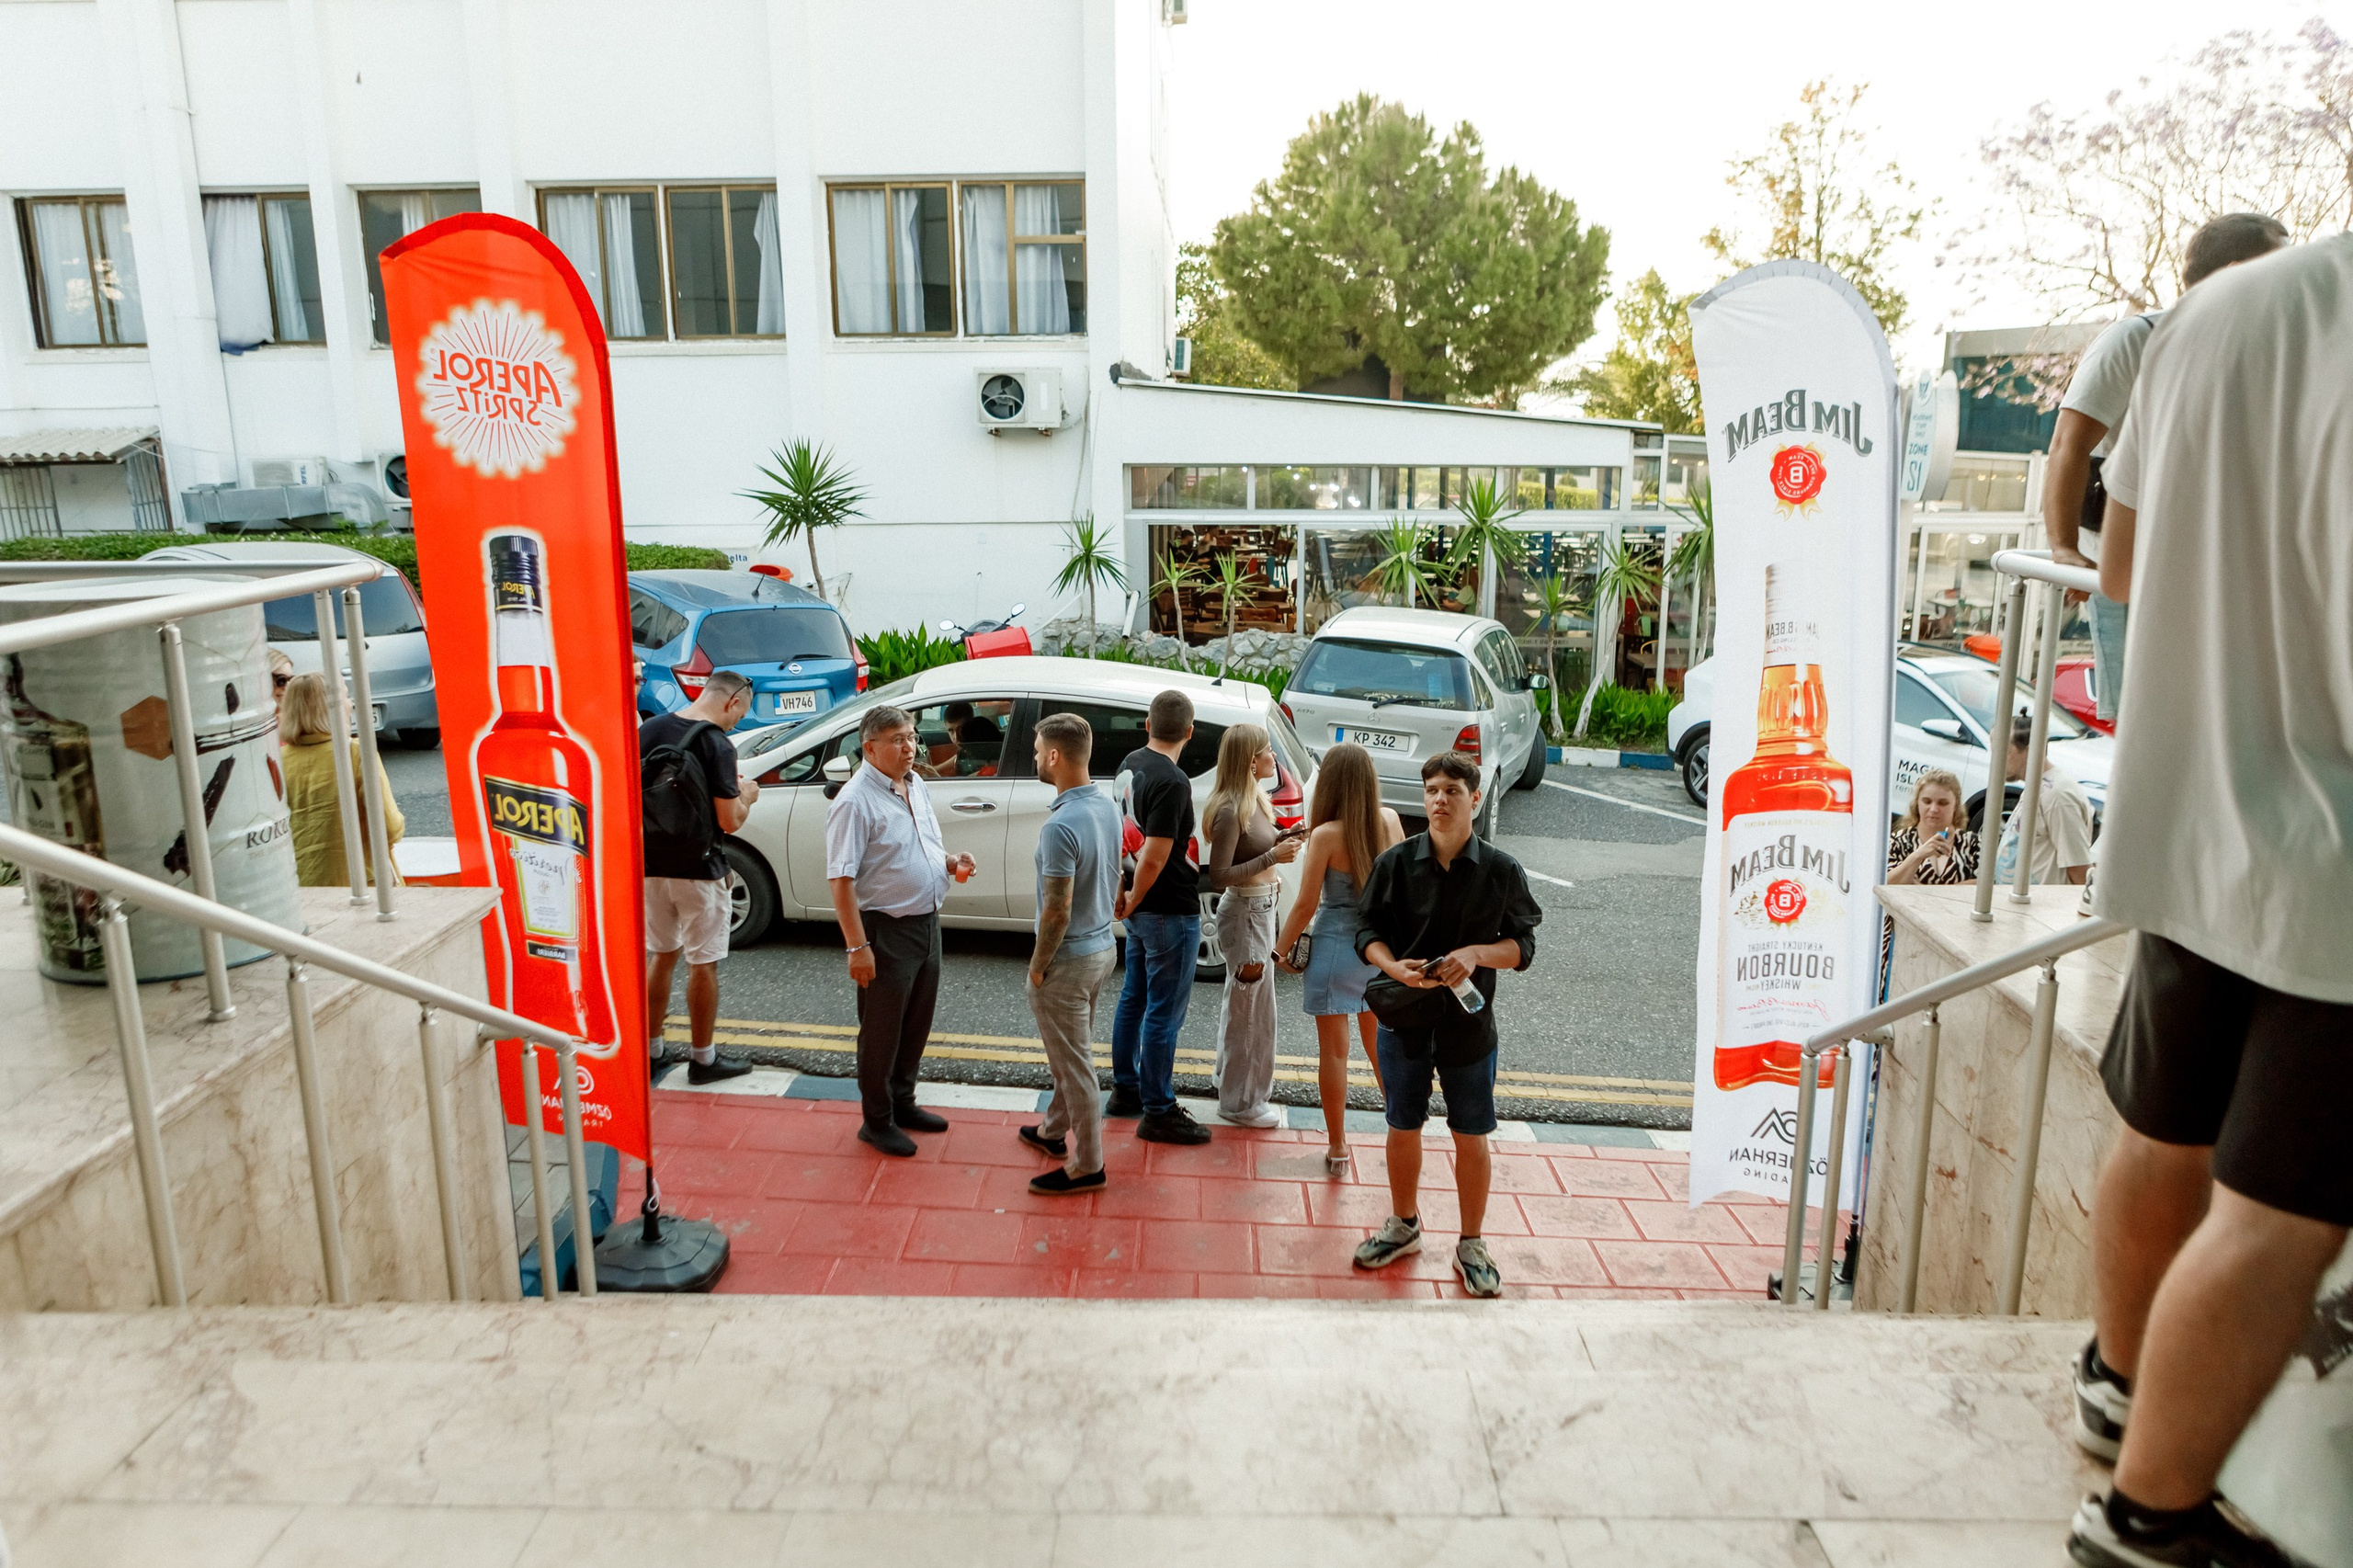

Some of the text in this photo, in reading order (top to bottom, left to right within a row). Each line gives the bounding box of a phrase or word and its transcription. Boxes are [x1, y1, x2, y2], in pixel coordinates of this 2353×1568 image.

[729, 553, 748, 563] elta
[1353, 732, 1396, 748] KP 342
[1898, 759, 1934, 775] MAG
